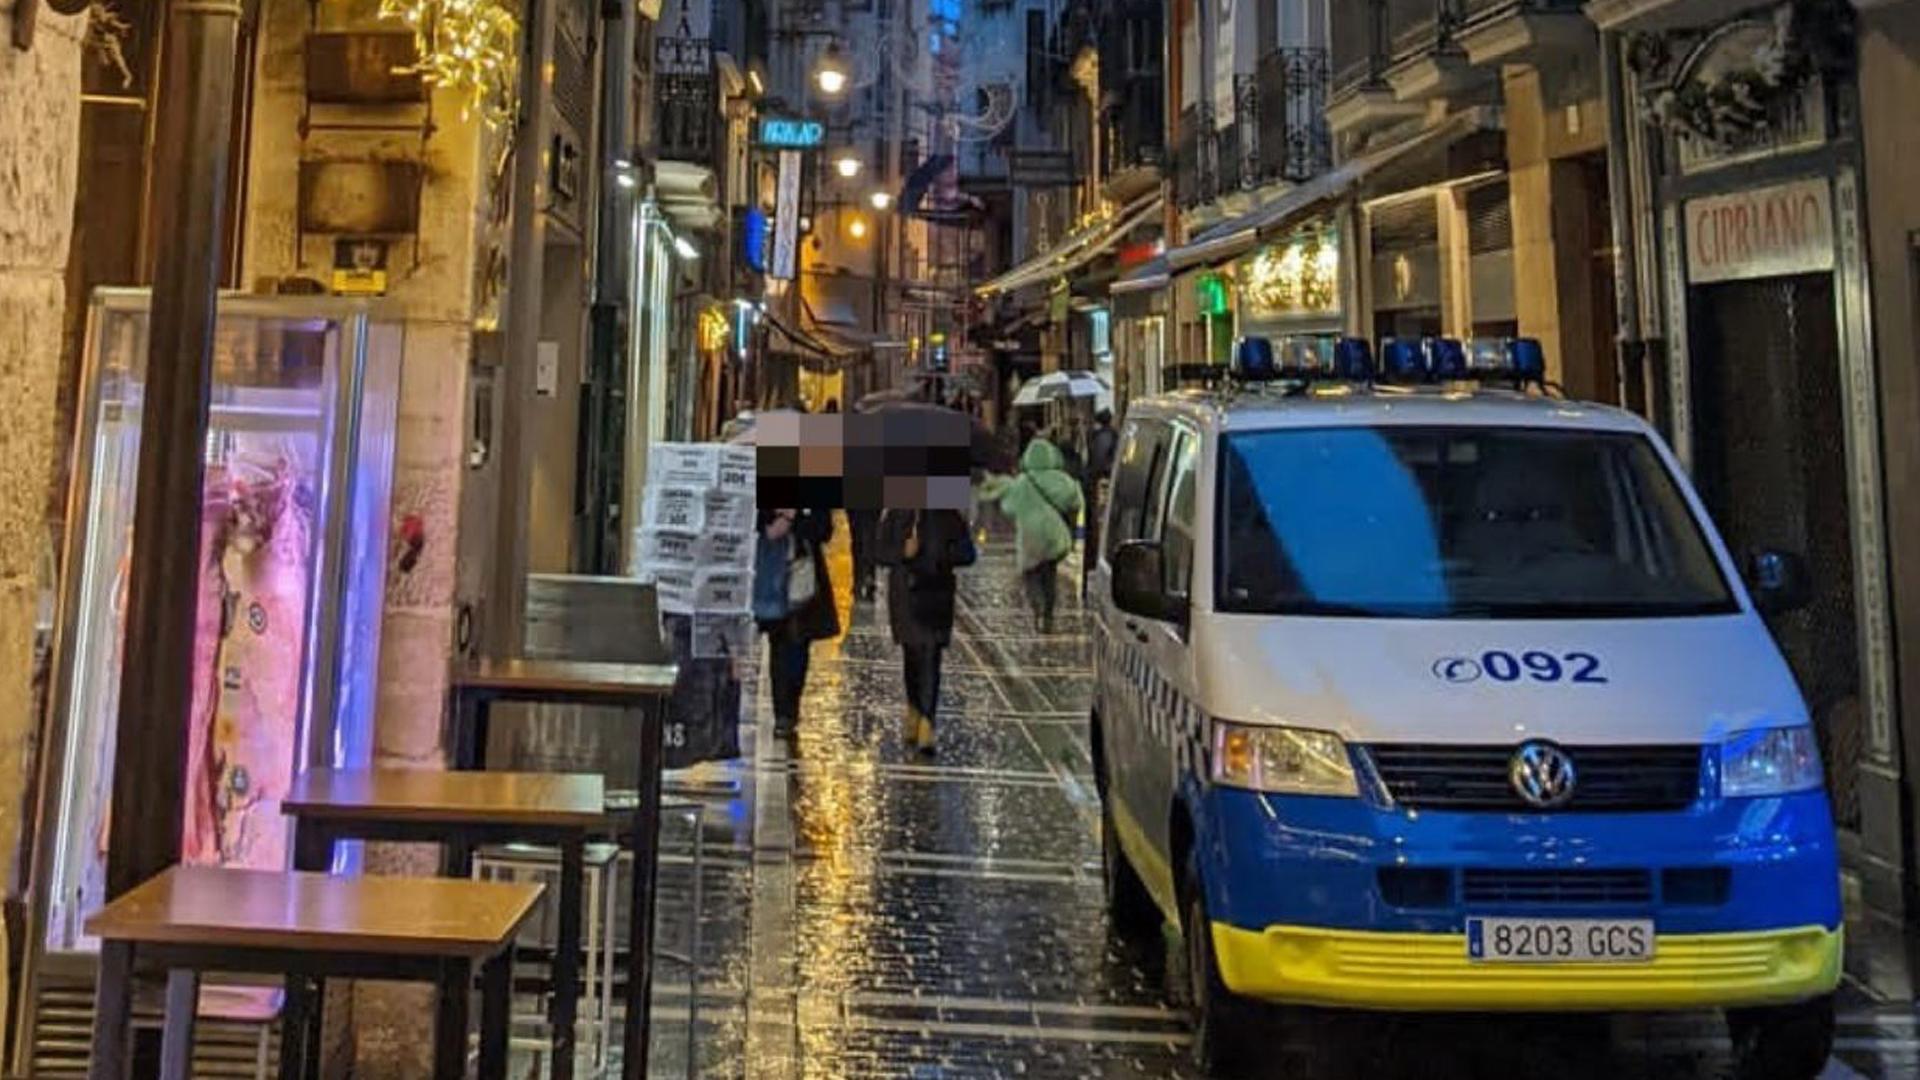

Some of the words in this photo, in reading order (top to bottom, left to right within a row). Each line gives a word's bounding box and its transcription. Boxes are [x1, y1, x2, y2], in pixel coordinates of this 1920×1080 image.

[1696, 193, 1822, 267] CIPRIANO
[1481, 650, 1609, 683] 092
[1494, 925, 1574, 956] 8203
[1588, 926, 1646, 956] GCS
